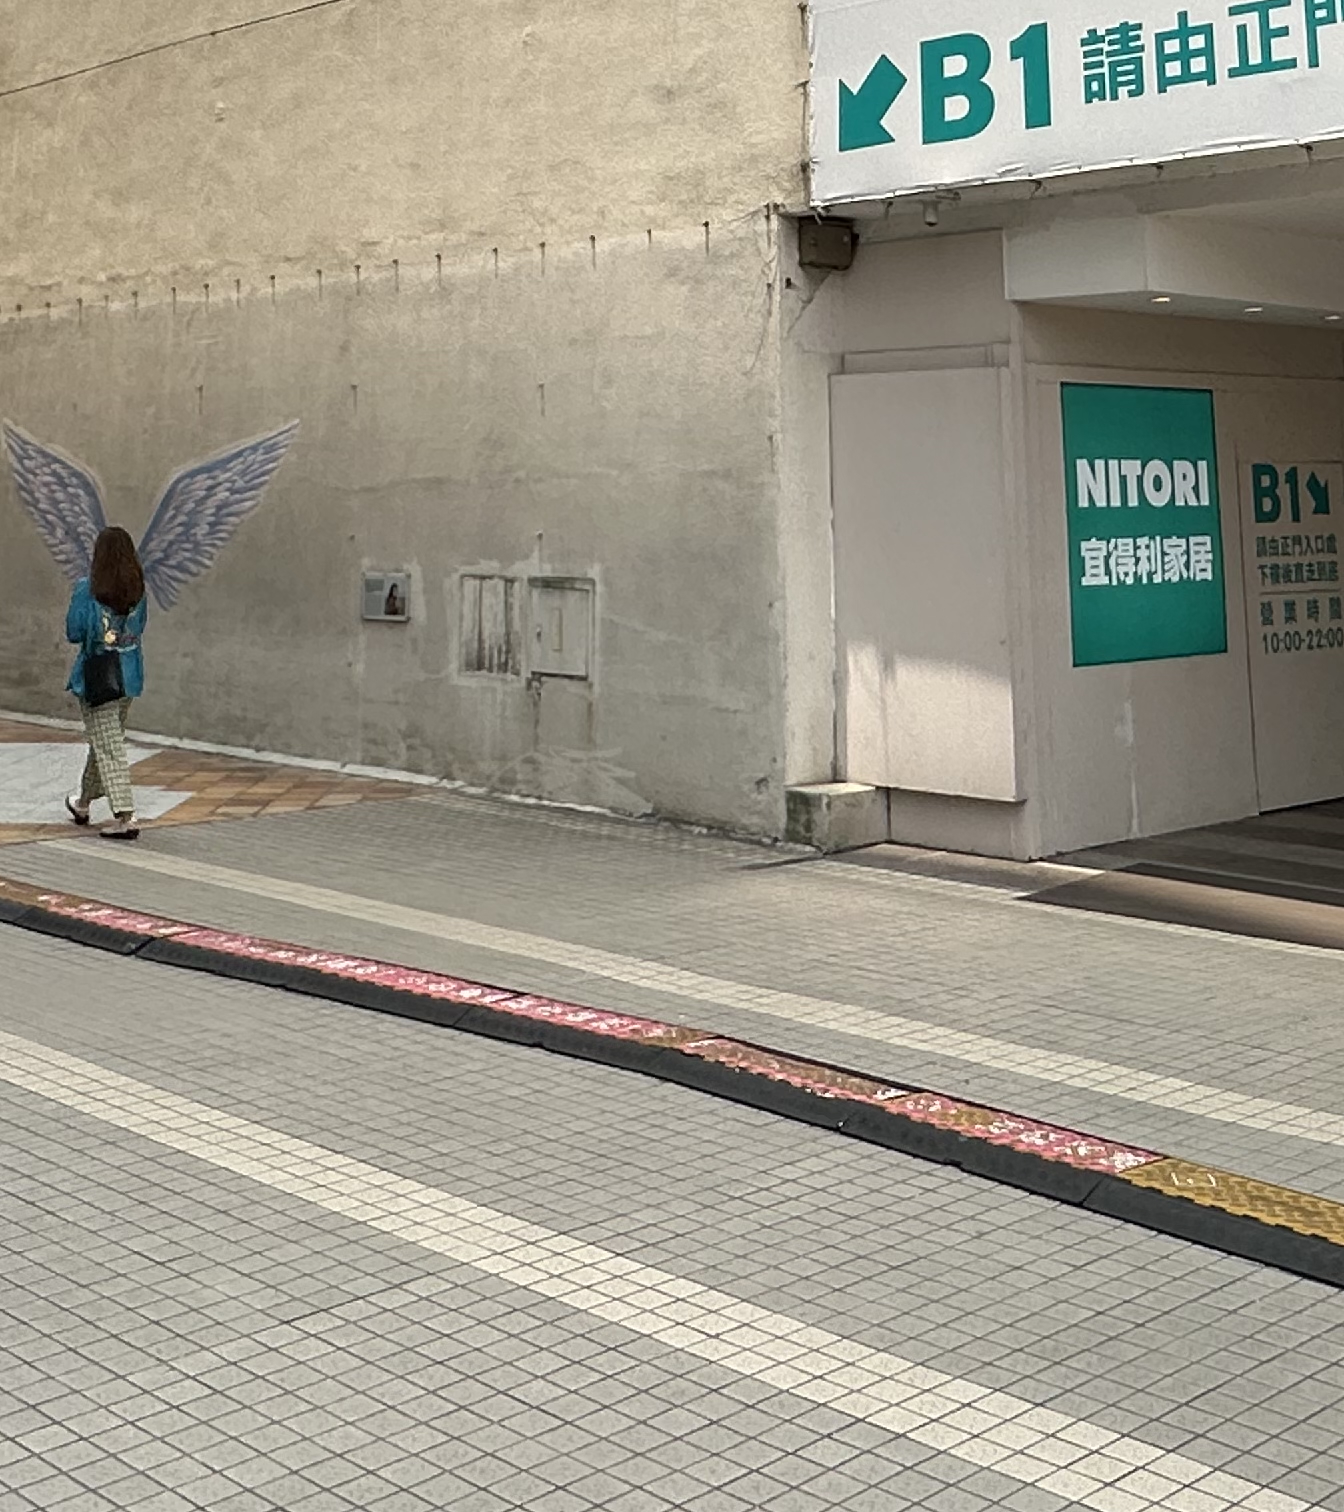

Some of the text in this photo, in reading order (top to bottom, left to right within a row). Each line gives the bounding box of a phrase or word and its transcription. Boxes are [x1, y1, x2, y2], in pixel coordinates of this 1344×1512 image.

[919, 21, 1052, 147] B1
[1076, 458, 1209, 507] NITORI
[1252, 463, 1301, 524] B1
[1081, 535, 1213, 585] 宜得利家居
